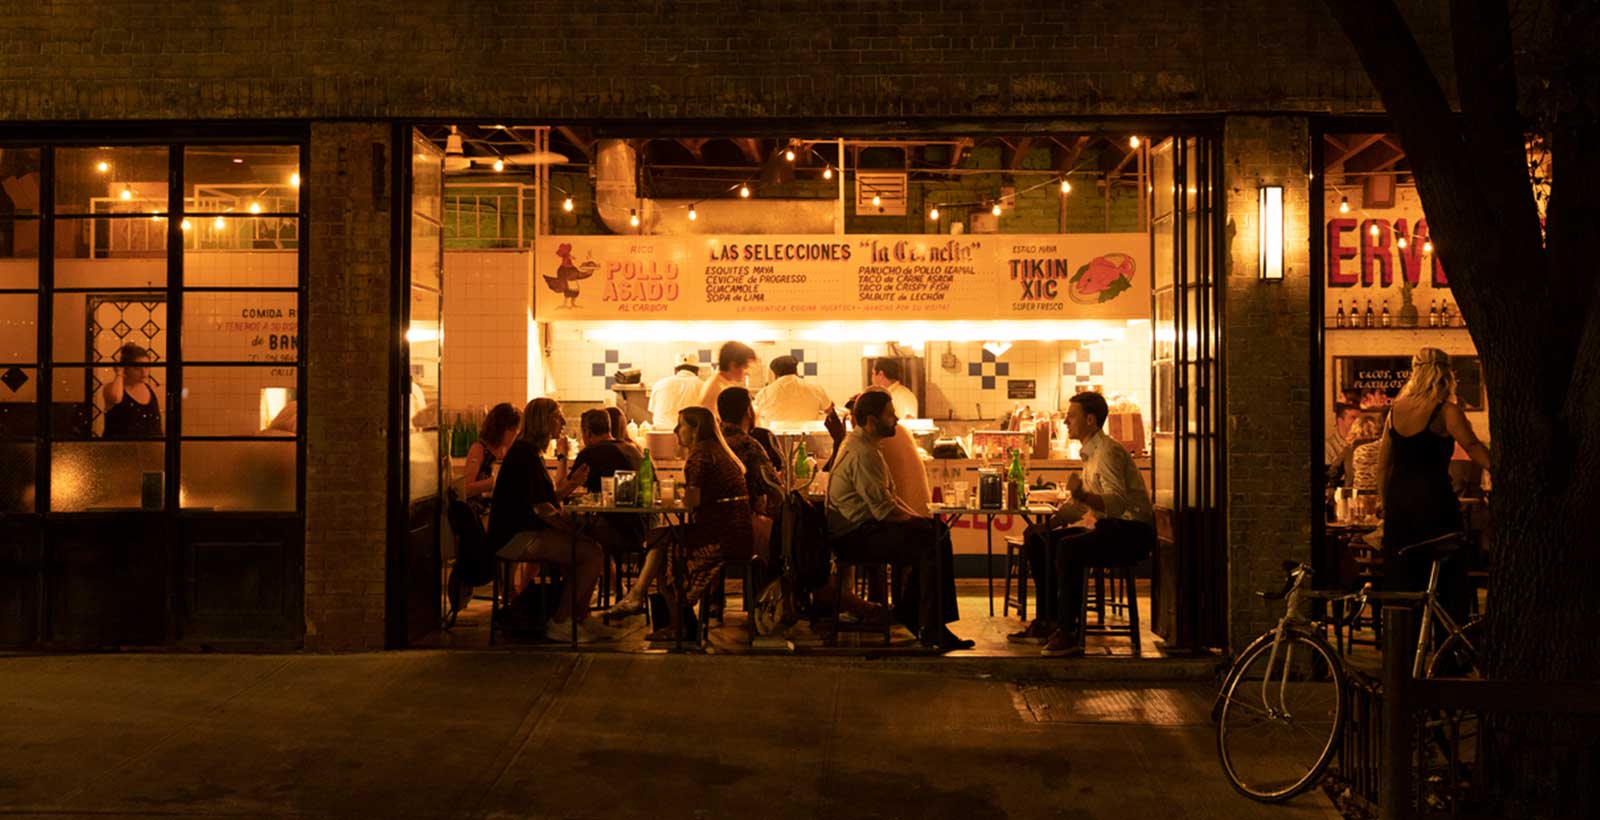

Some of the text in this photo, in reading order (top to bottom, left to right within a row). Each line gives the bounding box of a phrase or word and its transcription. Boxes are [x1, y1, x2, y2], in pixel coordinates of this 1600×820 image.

[630, 245, 654, 254] RICO
[709, 243, 852, 261] LAS SELECCIONES
[1012, 245, 1037, 254] ESTILO
[606, 259, 680, 281] POLLO
[705, 265, 775, 276] ESQUITES MAYA
[858, 266, 901, 276] PANUCHO
[902, 267, 913, 275] de
[914, 266, 942, 275] POLLO
[1008, 258, 1069, 280] TIKIN
[705, 274, 807, 285] CEVICHE de PROGRESSO
[858, 274, 954, 284] TACO de CARNE ASADA
[601, 281, 681, 302] ASADO
[705, 284, 760, 294] GUACAMOLE
[858, 283, 951, 293] TACO de CRISPY FISH
[1021, 279, 1058, 301] XIC
[705, 293, 765, 303] SOPA de LIMA
[858, 292, 896, 302] SALBUTE
[898, 292, 908, 301] de
[618, 303, 631, 312] AL
[242, 308, 283, 319] COMIDA
[251, 335, 264, 347] de
